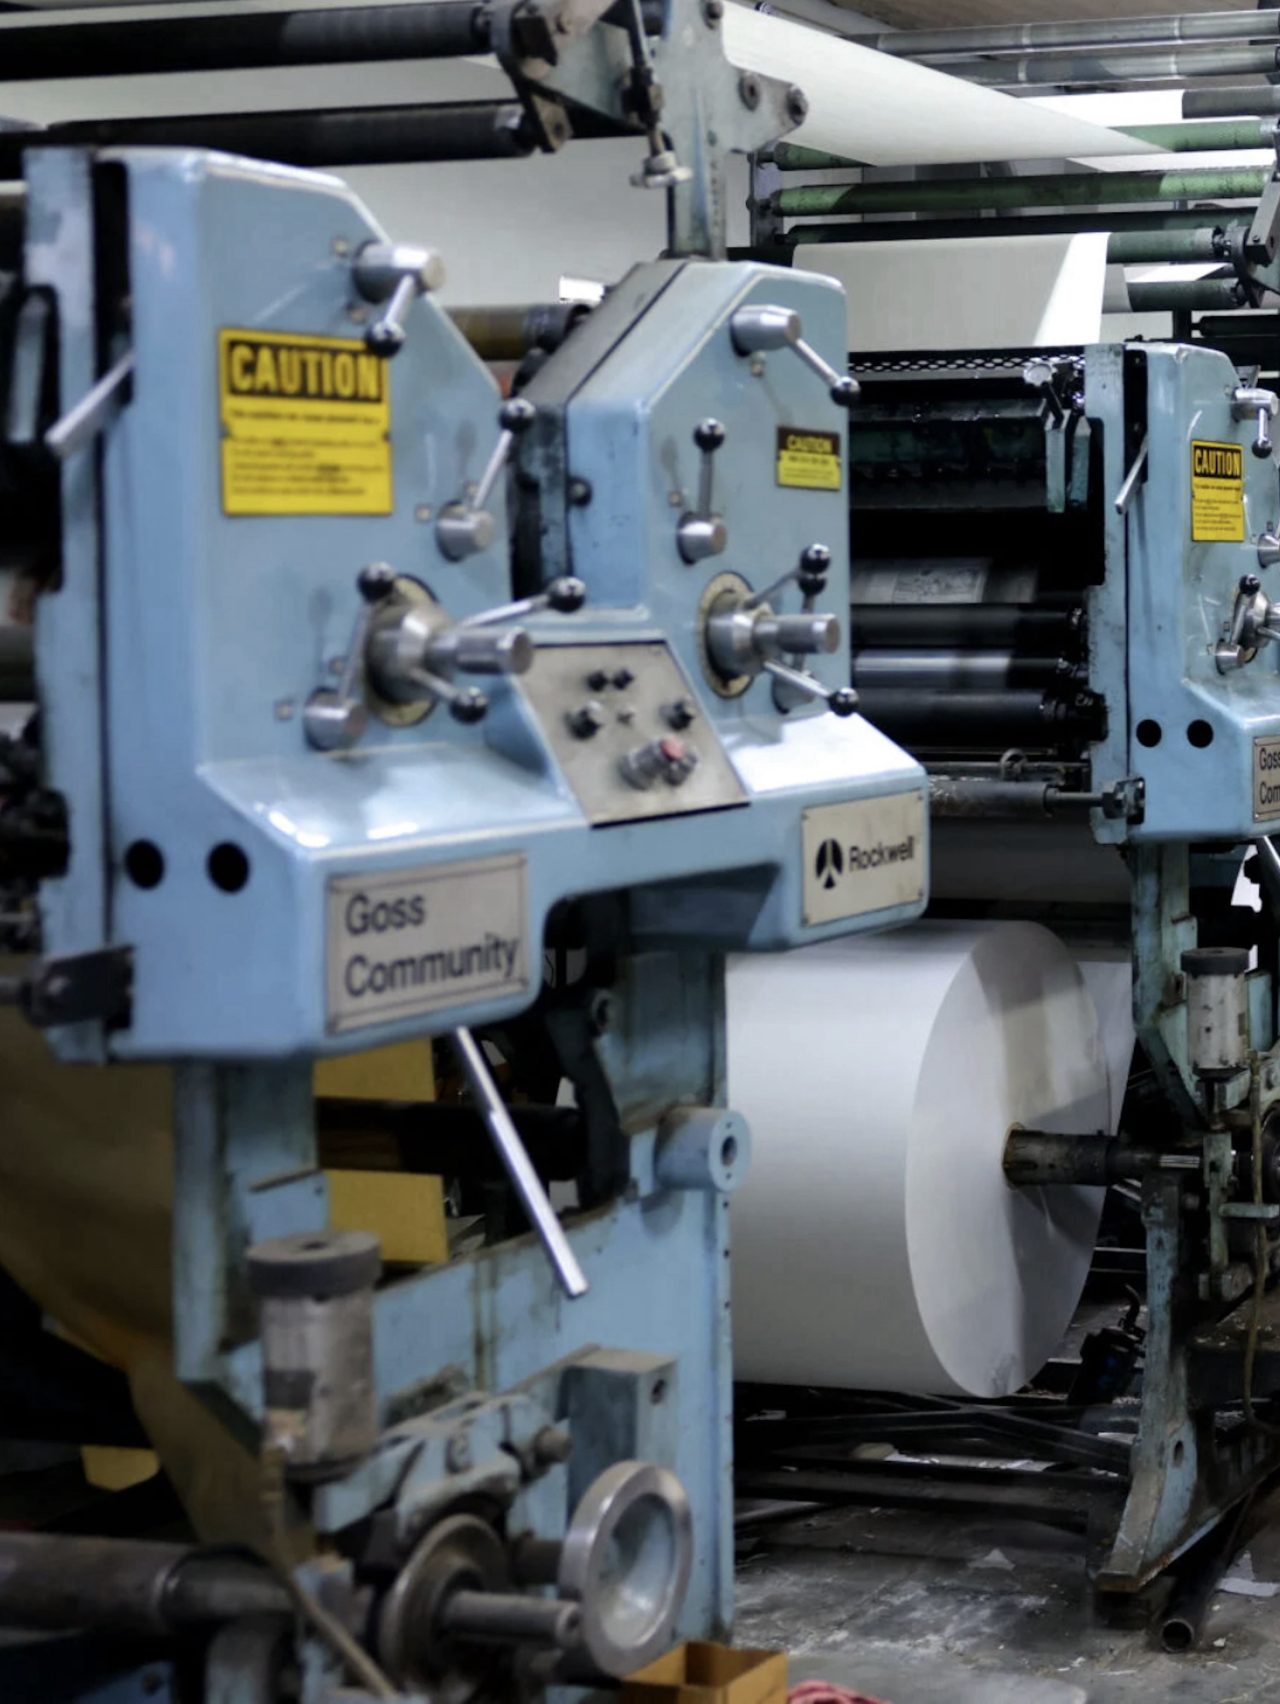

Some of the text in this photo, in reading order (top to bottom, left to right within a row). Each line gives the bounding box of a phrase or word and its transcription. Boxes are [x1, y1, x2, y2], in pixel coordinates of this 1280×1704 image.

[231, 344, 380, 399] CAUTION
[1194, 449, 1241, 476] CAUTION
[849, 835, 915, 872] Rockwell
[345, 892, 425, 936] Goss
[345, 932, 520, 998] Community
